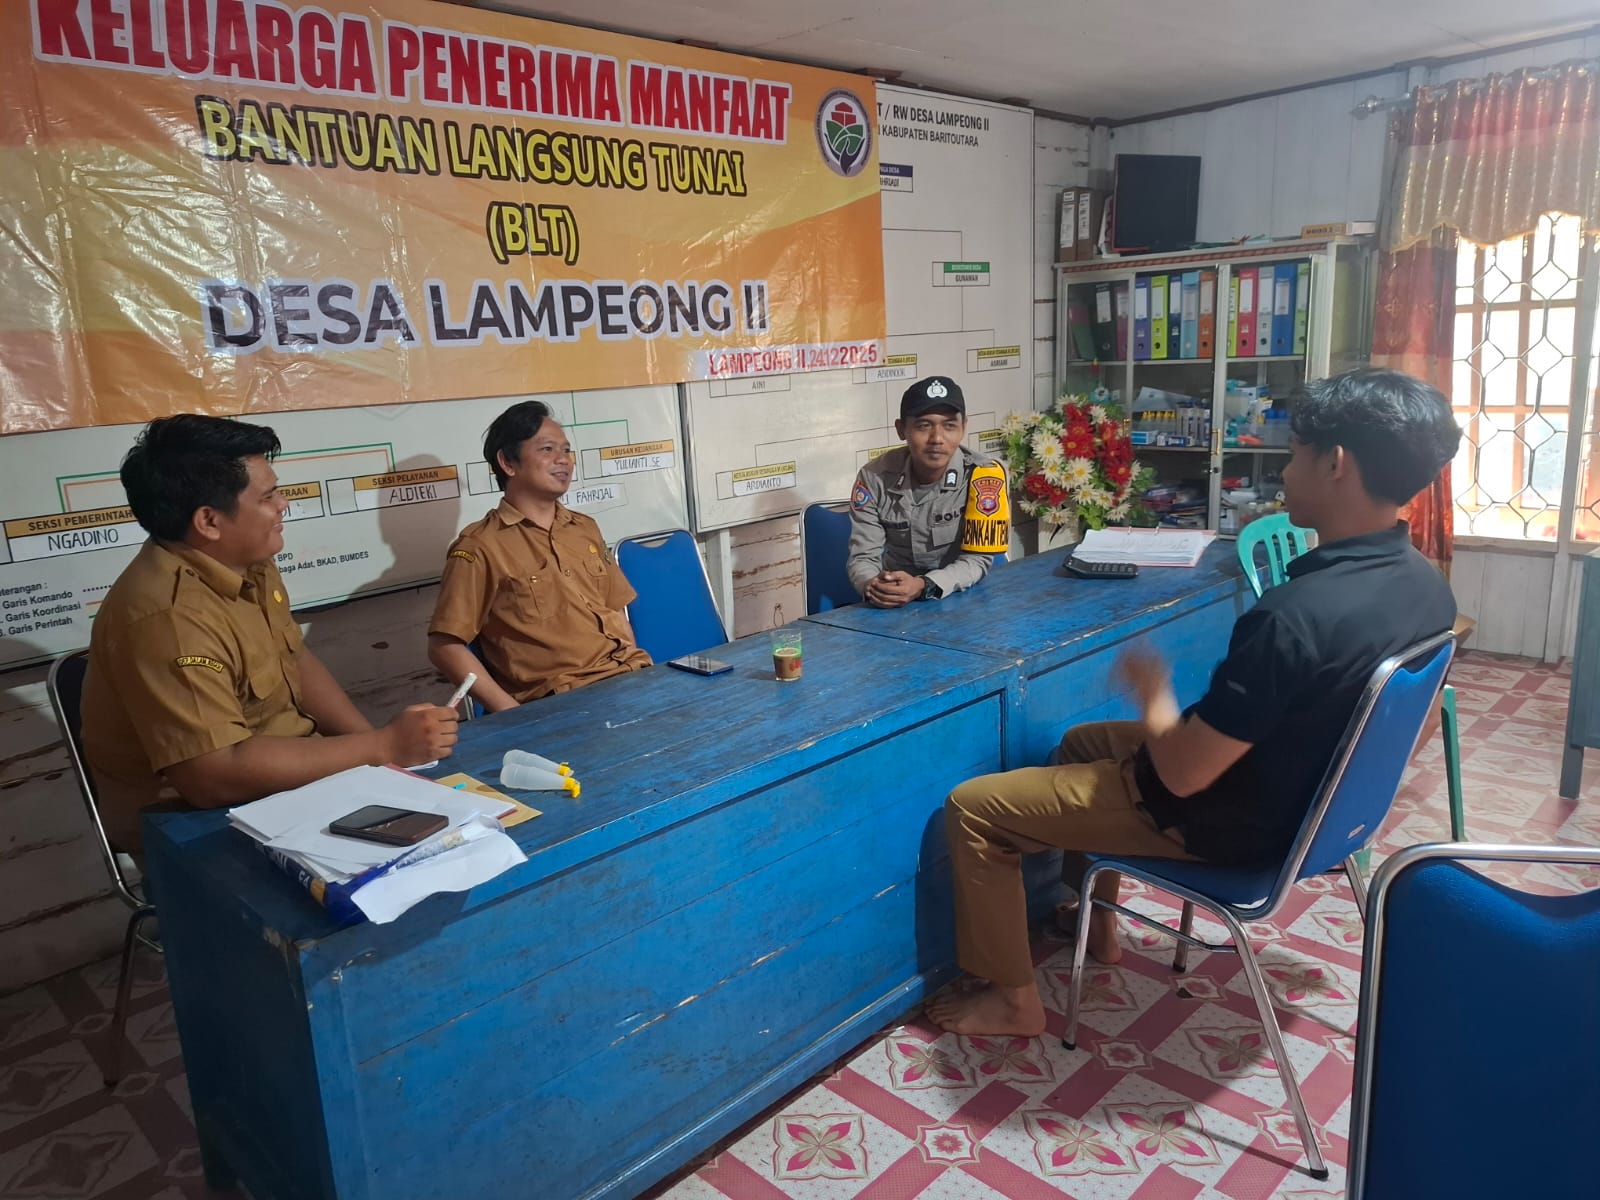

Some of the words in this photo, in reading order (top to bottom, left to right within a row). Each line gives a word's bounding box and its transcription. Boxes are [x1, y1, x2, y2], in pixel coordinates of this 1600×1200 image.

[36, 0, 378, 95] KELUARGA
[386, 24, 622, 124] PENERIMA
[629, 62, 791, 143] MANFAAT
[893, 105, 909, 121] RW
[910, 108, 934, 124] DESA
[935, 112, 983, 130] LAMPEONG
[882, 125, 929, 142] KABUPATEN
[196, 96, 440, 175] BANTUAN
[445, 121, 647, 191] LANGSUNG
[650, 142, 747, 196] TUNAI
[487, 201, 580, 266] (BLT)
[203, 283, 413, 349] DESA
[429, 282, 731, 340] LAMPEONG
[743, 283, 769, 331] II
[709, 350, 793, 376] LAMPEONG
[610, 447, 634, 457] URUSAN
[372, 476, 395, 486] SEKSI
[396, 471, 439, 484] PELAYANAN
[28, 518, 62, 531] SEKSI
[48, 528, 119, 551] NGADINO
[277, 552, 294, 562] BPD
[316, 556, 339, 567] BKAD,
[340, 551, 369, 562] BUMDES
[2, 598, 28, 609] Garis
[29, 591, 73, 605] Komando
[5, 611, 31, 622] Garis
[32, 601, 81, 618] Koordinasi
[8, 624, 33, 635] Garis
[35, 616, 73, 630] Perintah
